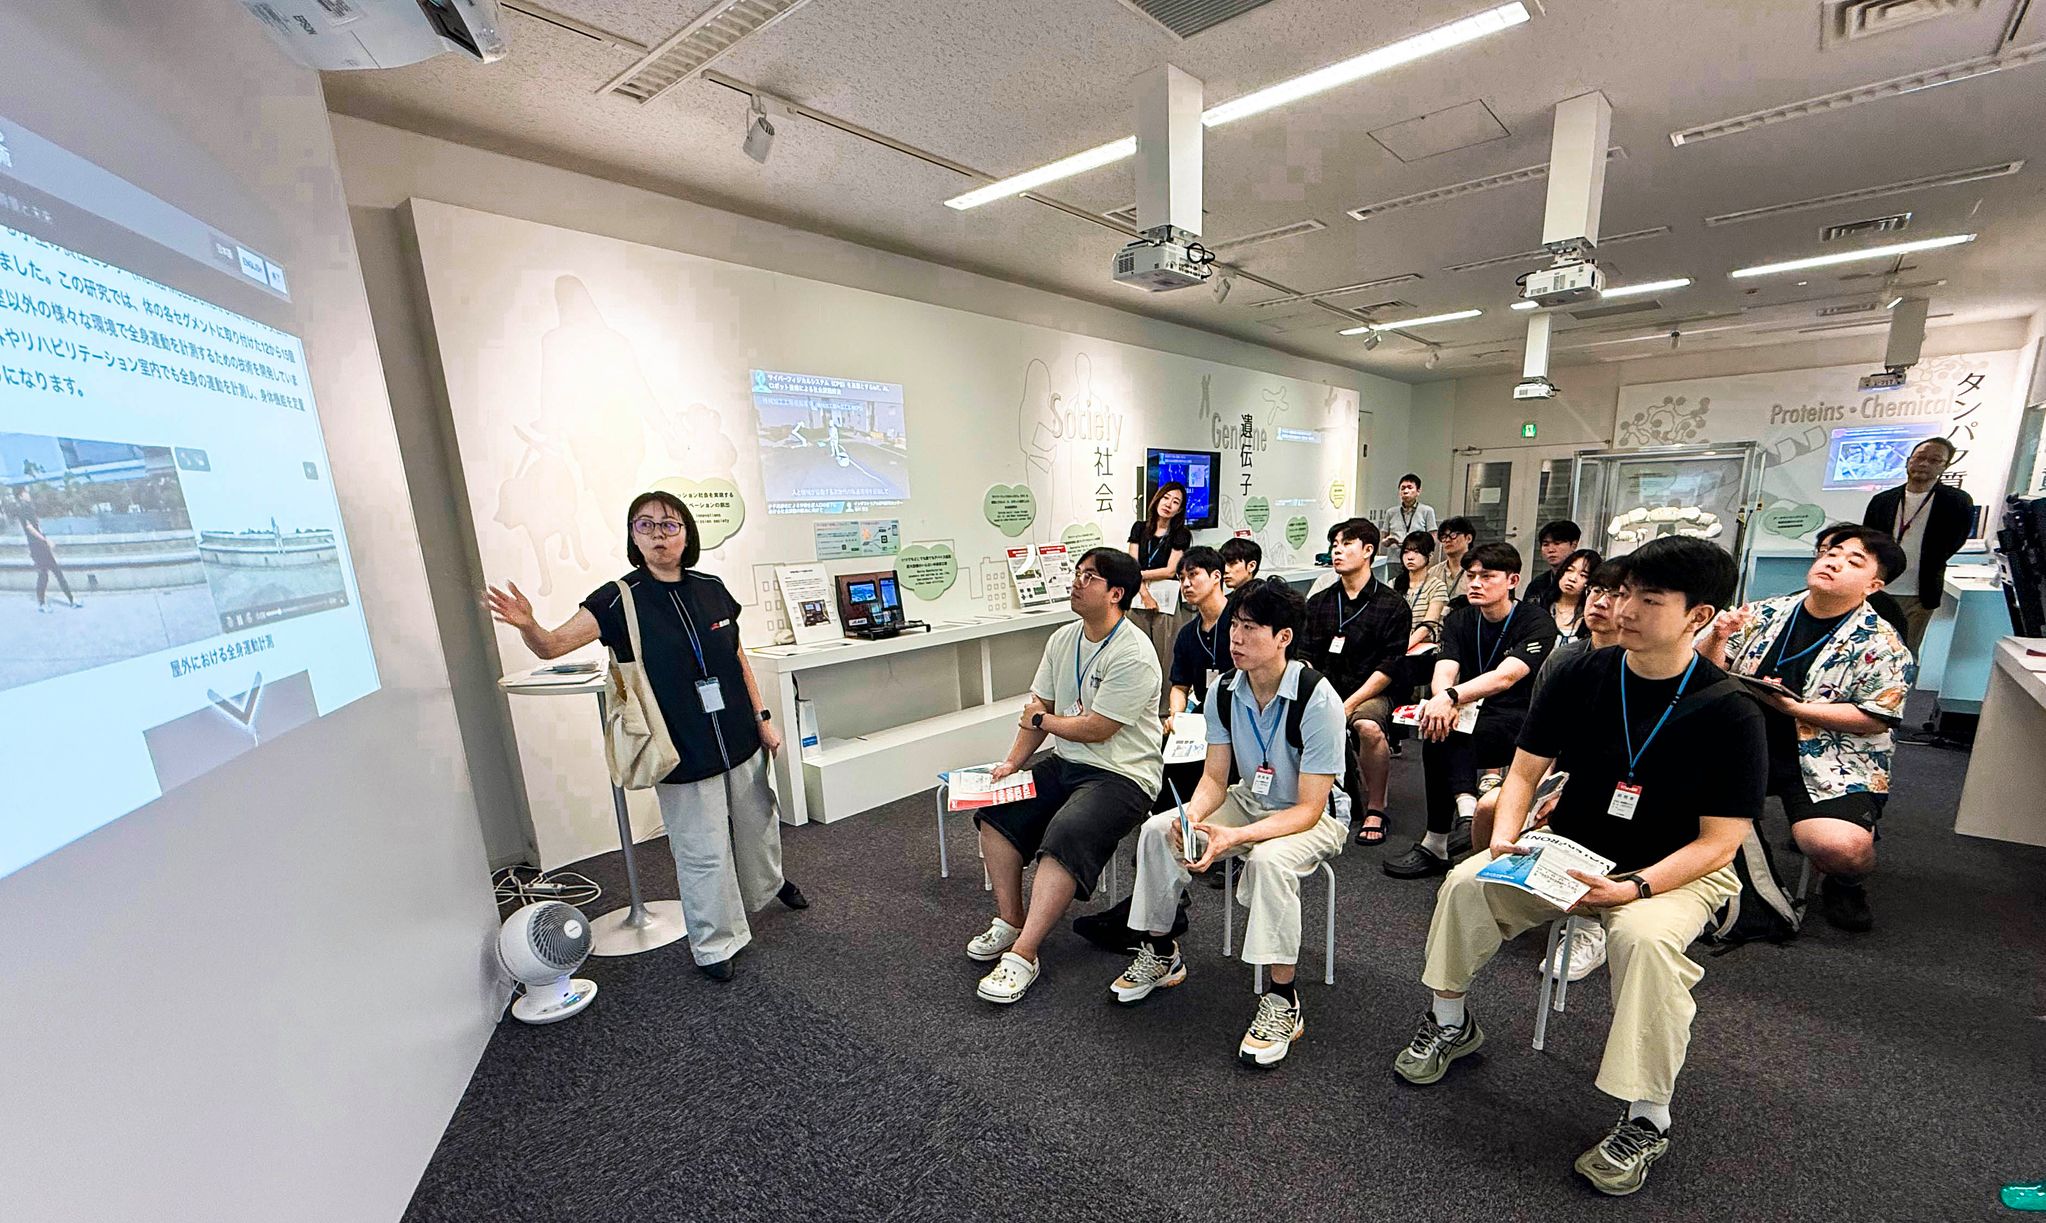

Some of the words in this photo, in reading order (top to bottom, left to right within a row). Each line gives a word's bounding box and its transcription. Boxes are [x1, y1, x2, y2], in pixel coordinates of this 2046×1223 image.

[0, 364, 84, 397] になります。
[1769, 401, 1845, 425] Proteins
[1094, 446, 1114, 512] 社会
[1239, 413, 1253, 496] 遺伝子
